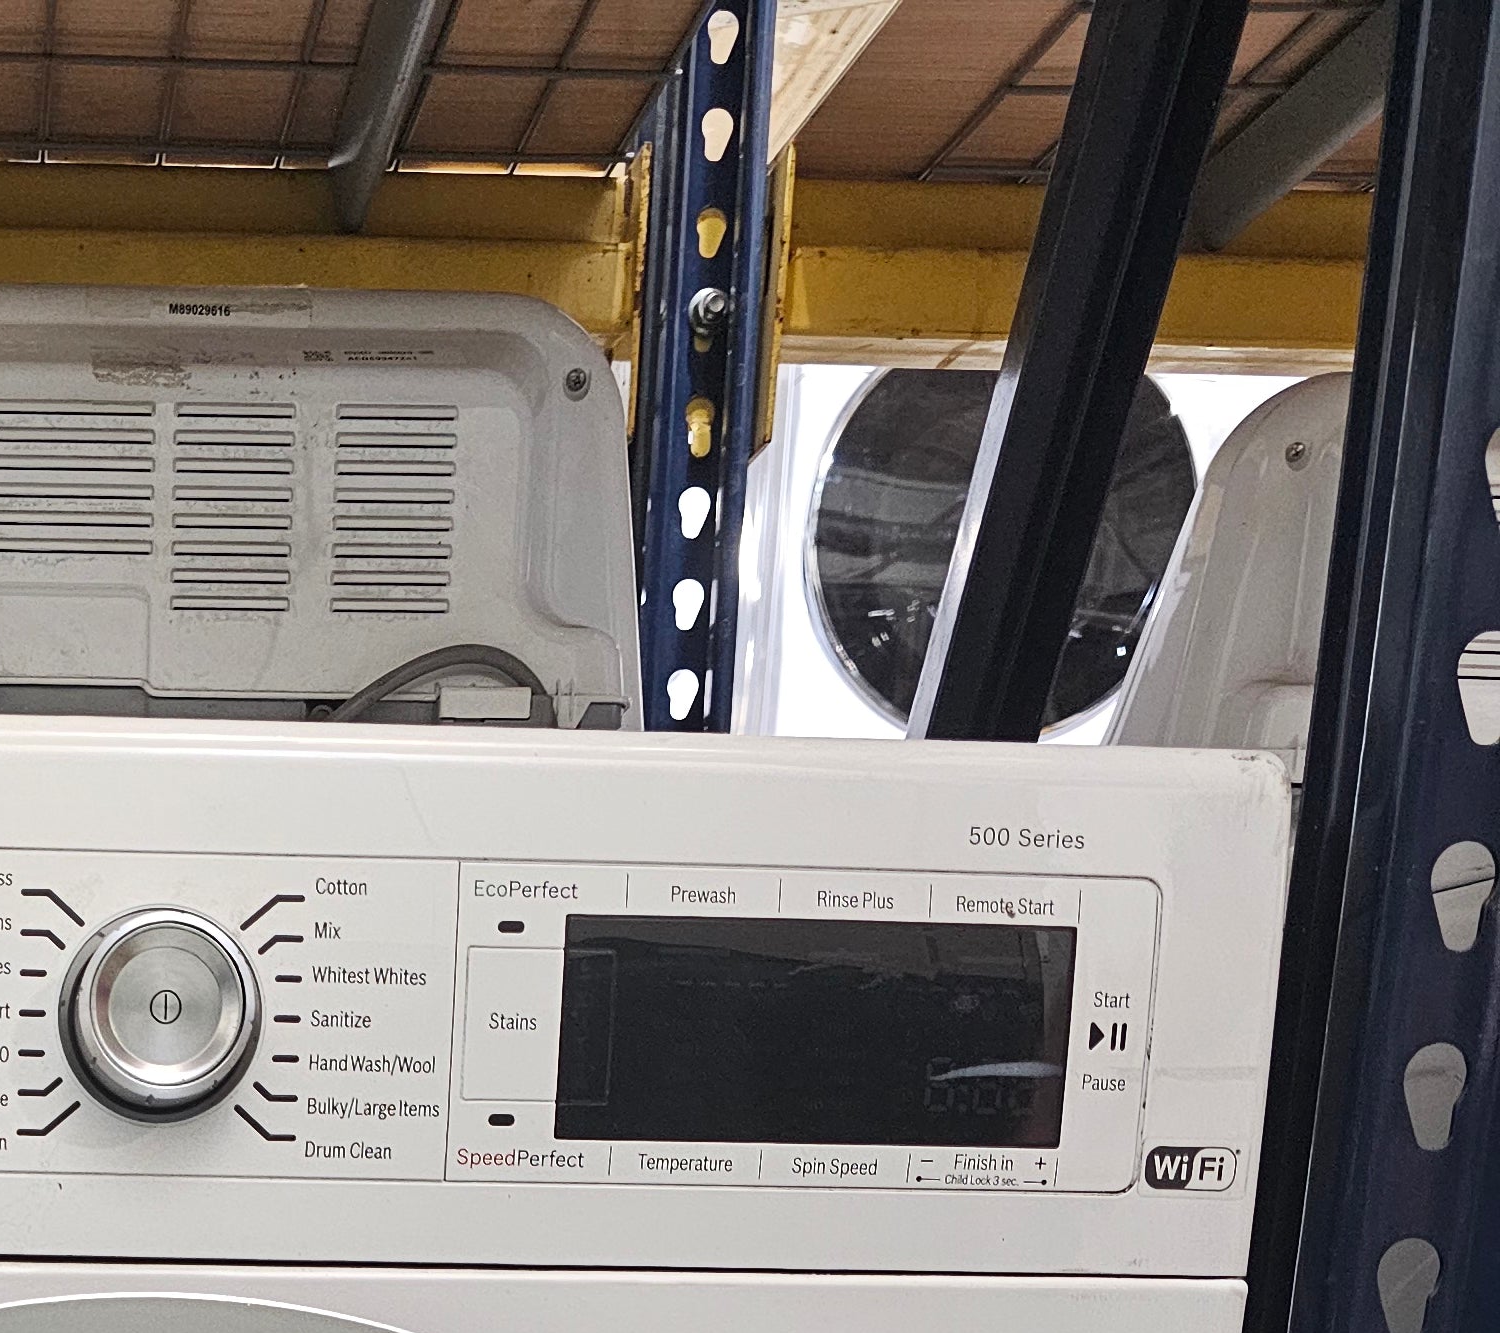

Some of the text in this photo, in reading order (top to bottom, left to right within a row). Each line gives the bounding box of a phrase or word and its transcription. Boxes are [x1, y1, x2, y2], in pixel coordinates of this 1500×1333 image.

[969, 826, 1085, 850] 500 Series
[315, 878, 367, 895] Cotton
[474, 879, 578, 899] EcoPerfect
[671, 885, 736, 904] Prewash
[817, 890, 894, 910] Rinse Plus
[956, 896, 1054, 916] Remote Start
[314, 922, 341, 940] Mix
[312, 966, 426, 986] Whitest Whites
[1093, 991, 1130, 1009] Start
[310, 1010, 371, 1028] Sanitize
[489, 1012, 537, 1031] Stains
[309, 1054, 436, 1076] Hand Wash/Wool
[1082, 1074, 1126, 1092] Pause
[307, 1098, 440, 1119] Bulky/Large Items
[305, 1141, 392, 1160] Drum Clean
[457, 1148, 584, 1169] SpeedPerfect
[638, 1153, 733, 1174] Temperature
[792, 1157, 878, 1177] Spin Speed
[954, 1154, 1014, 1171] Finish in
[944, 1173, 968, 1186] Child
[970, 1174, 992, 1186] Lock
[993, 1175, 1000, 1186] 3
